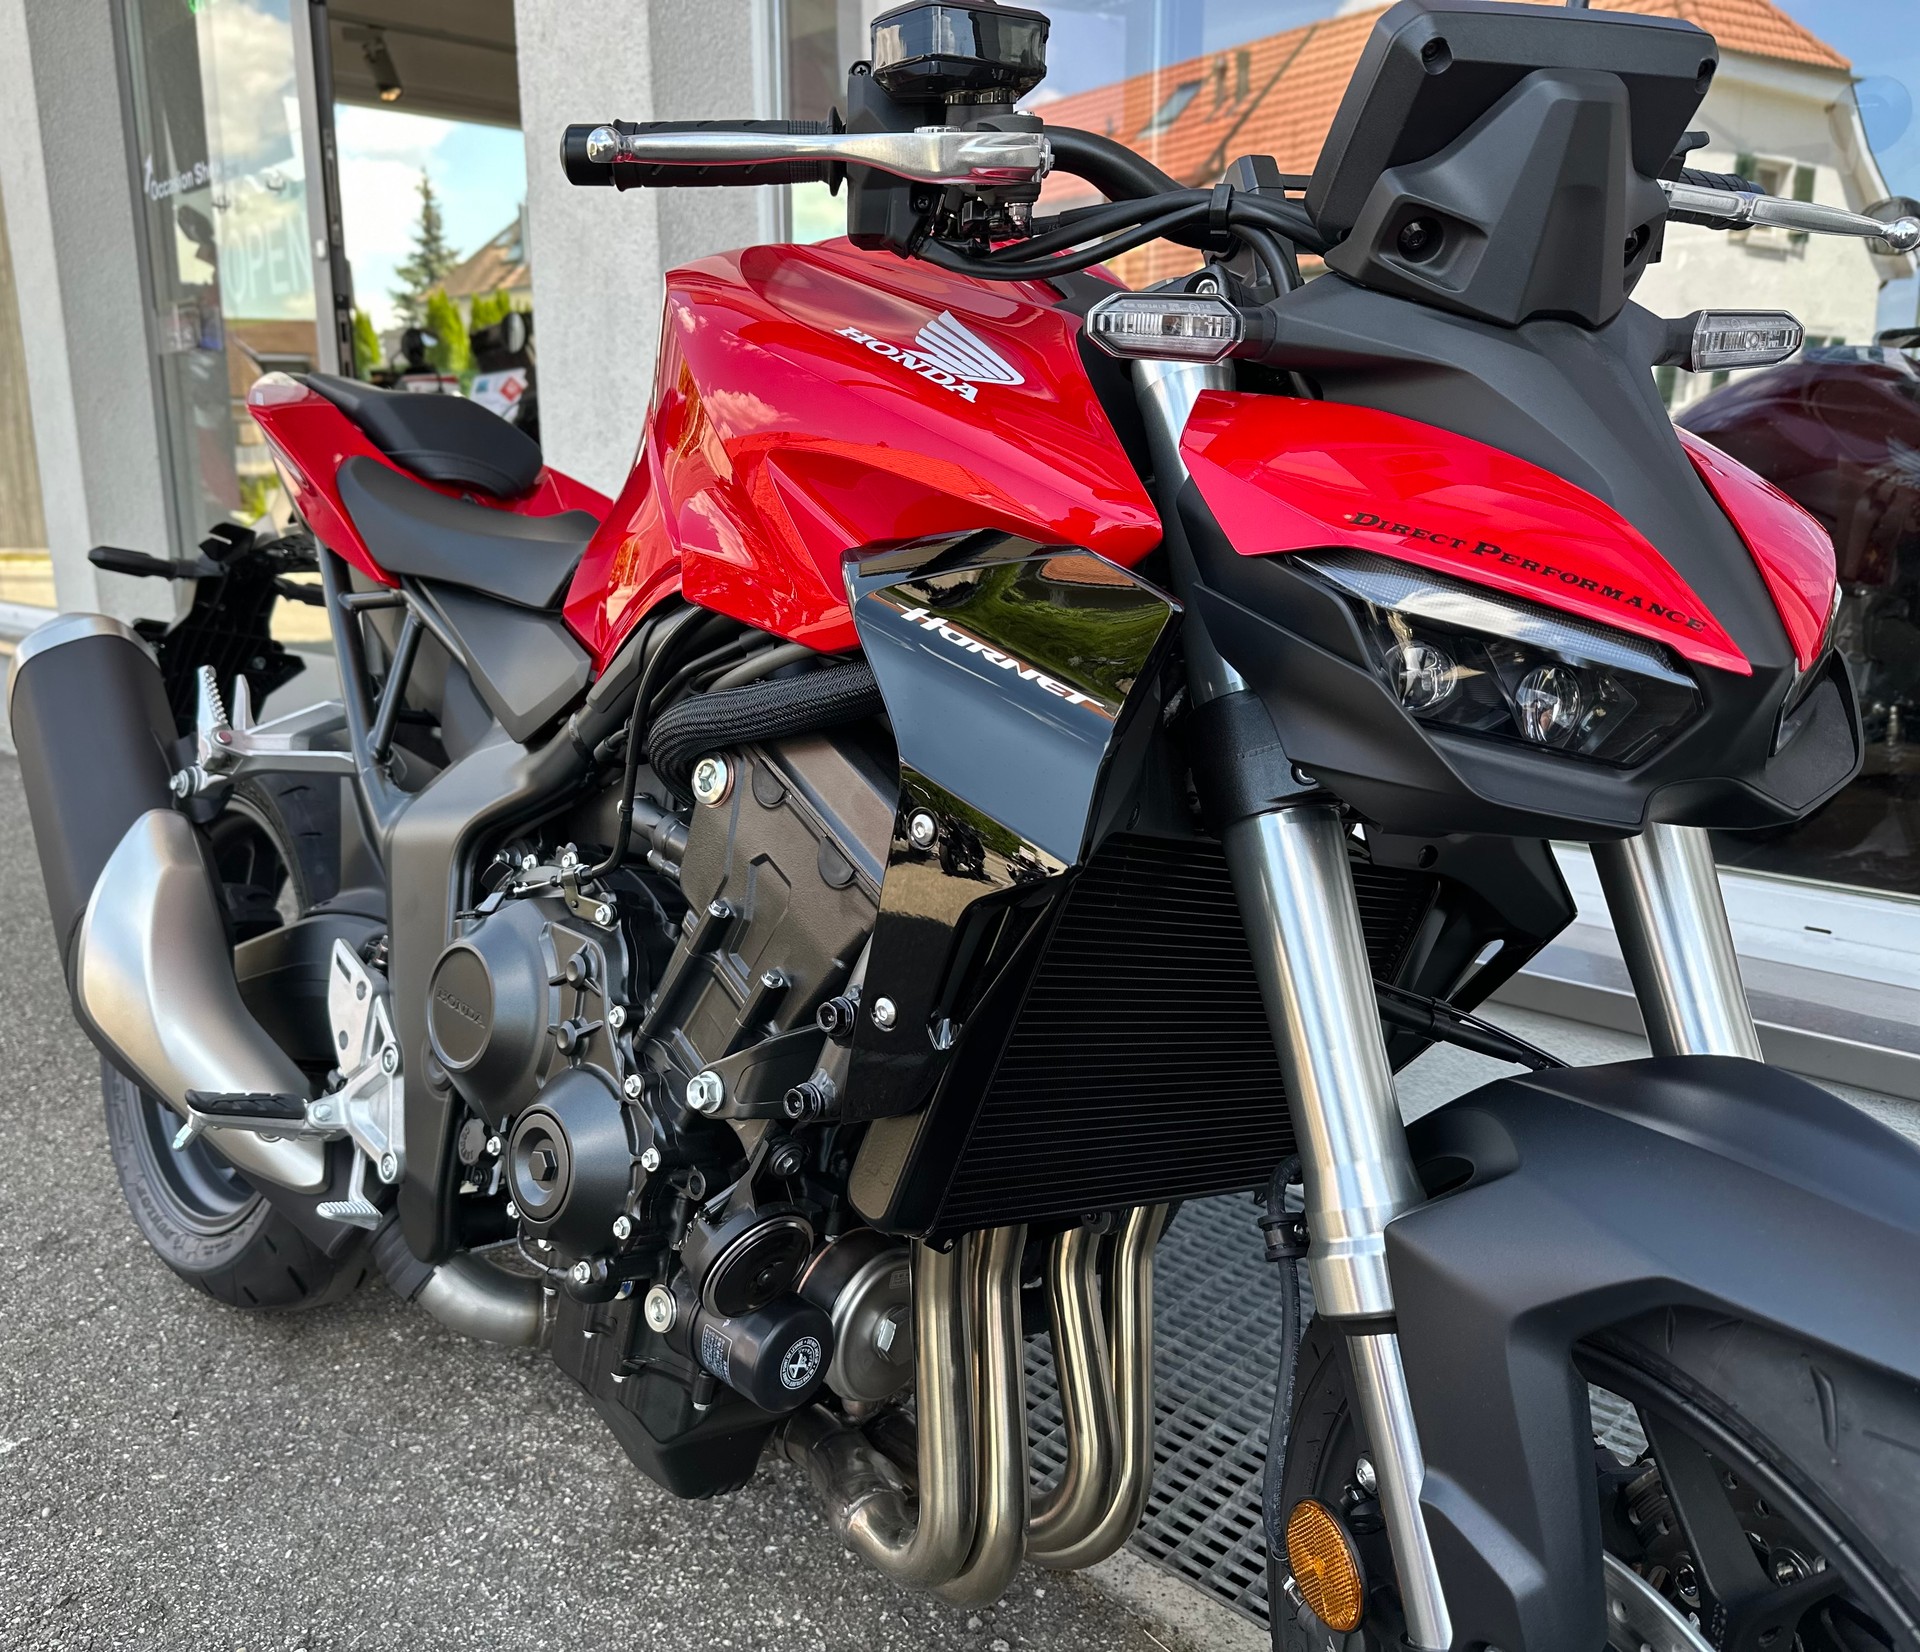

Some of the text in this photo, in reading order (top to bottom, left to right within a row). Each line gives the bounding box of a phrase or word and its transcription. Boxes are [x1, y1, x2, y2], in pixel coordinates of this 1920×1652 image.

[221, 212, 313, 304] OPEN
[834, 326, 979, 403] HONDA
[896, 602, 1106, 707] HORNET
[436, 988, 486, 1029] HONDA
